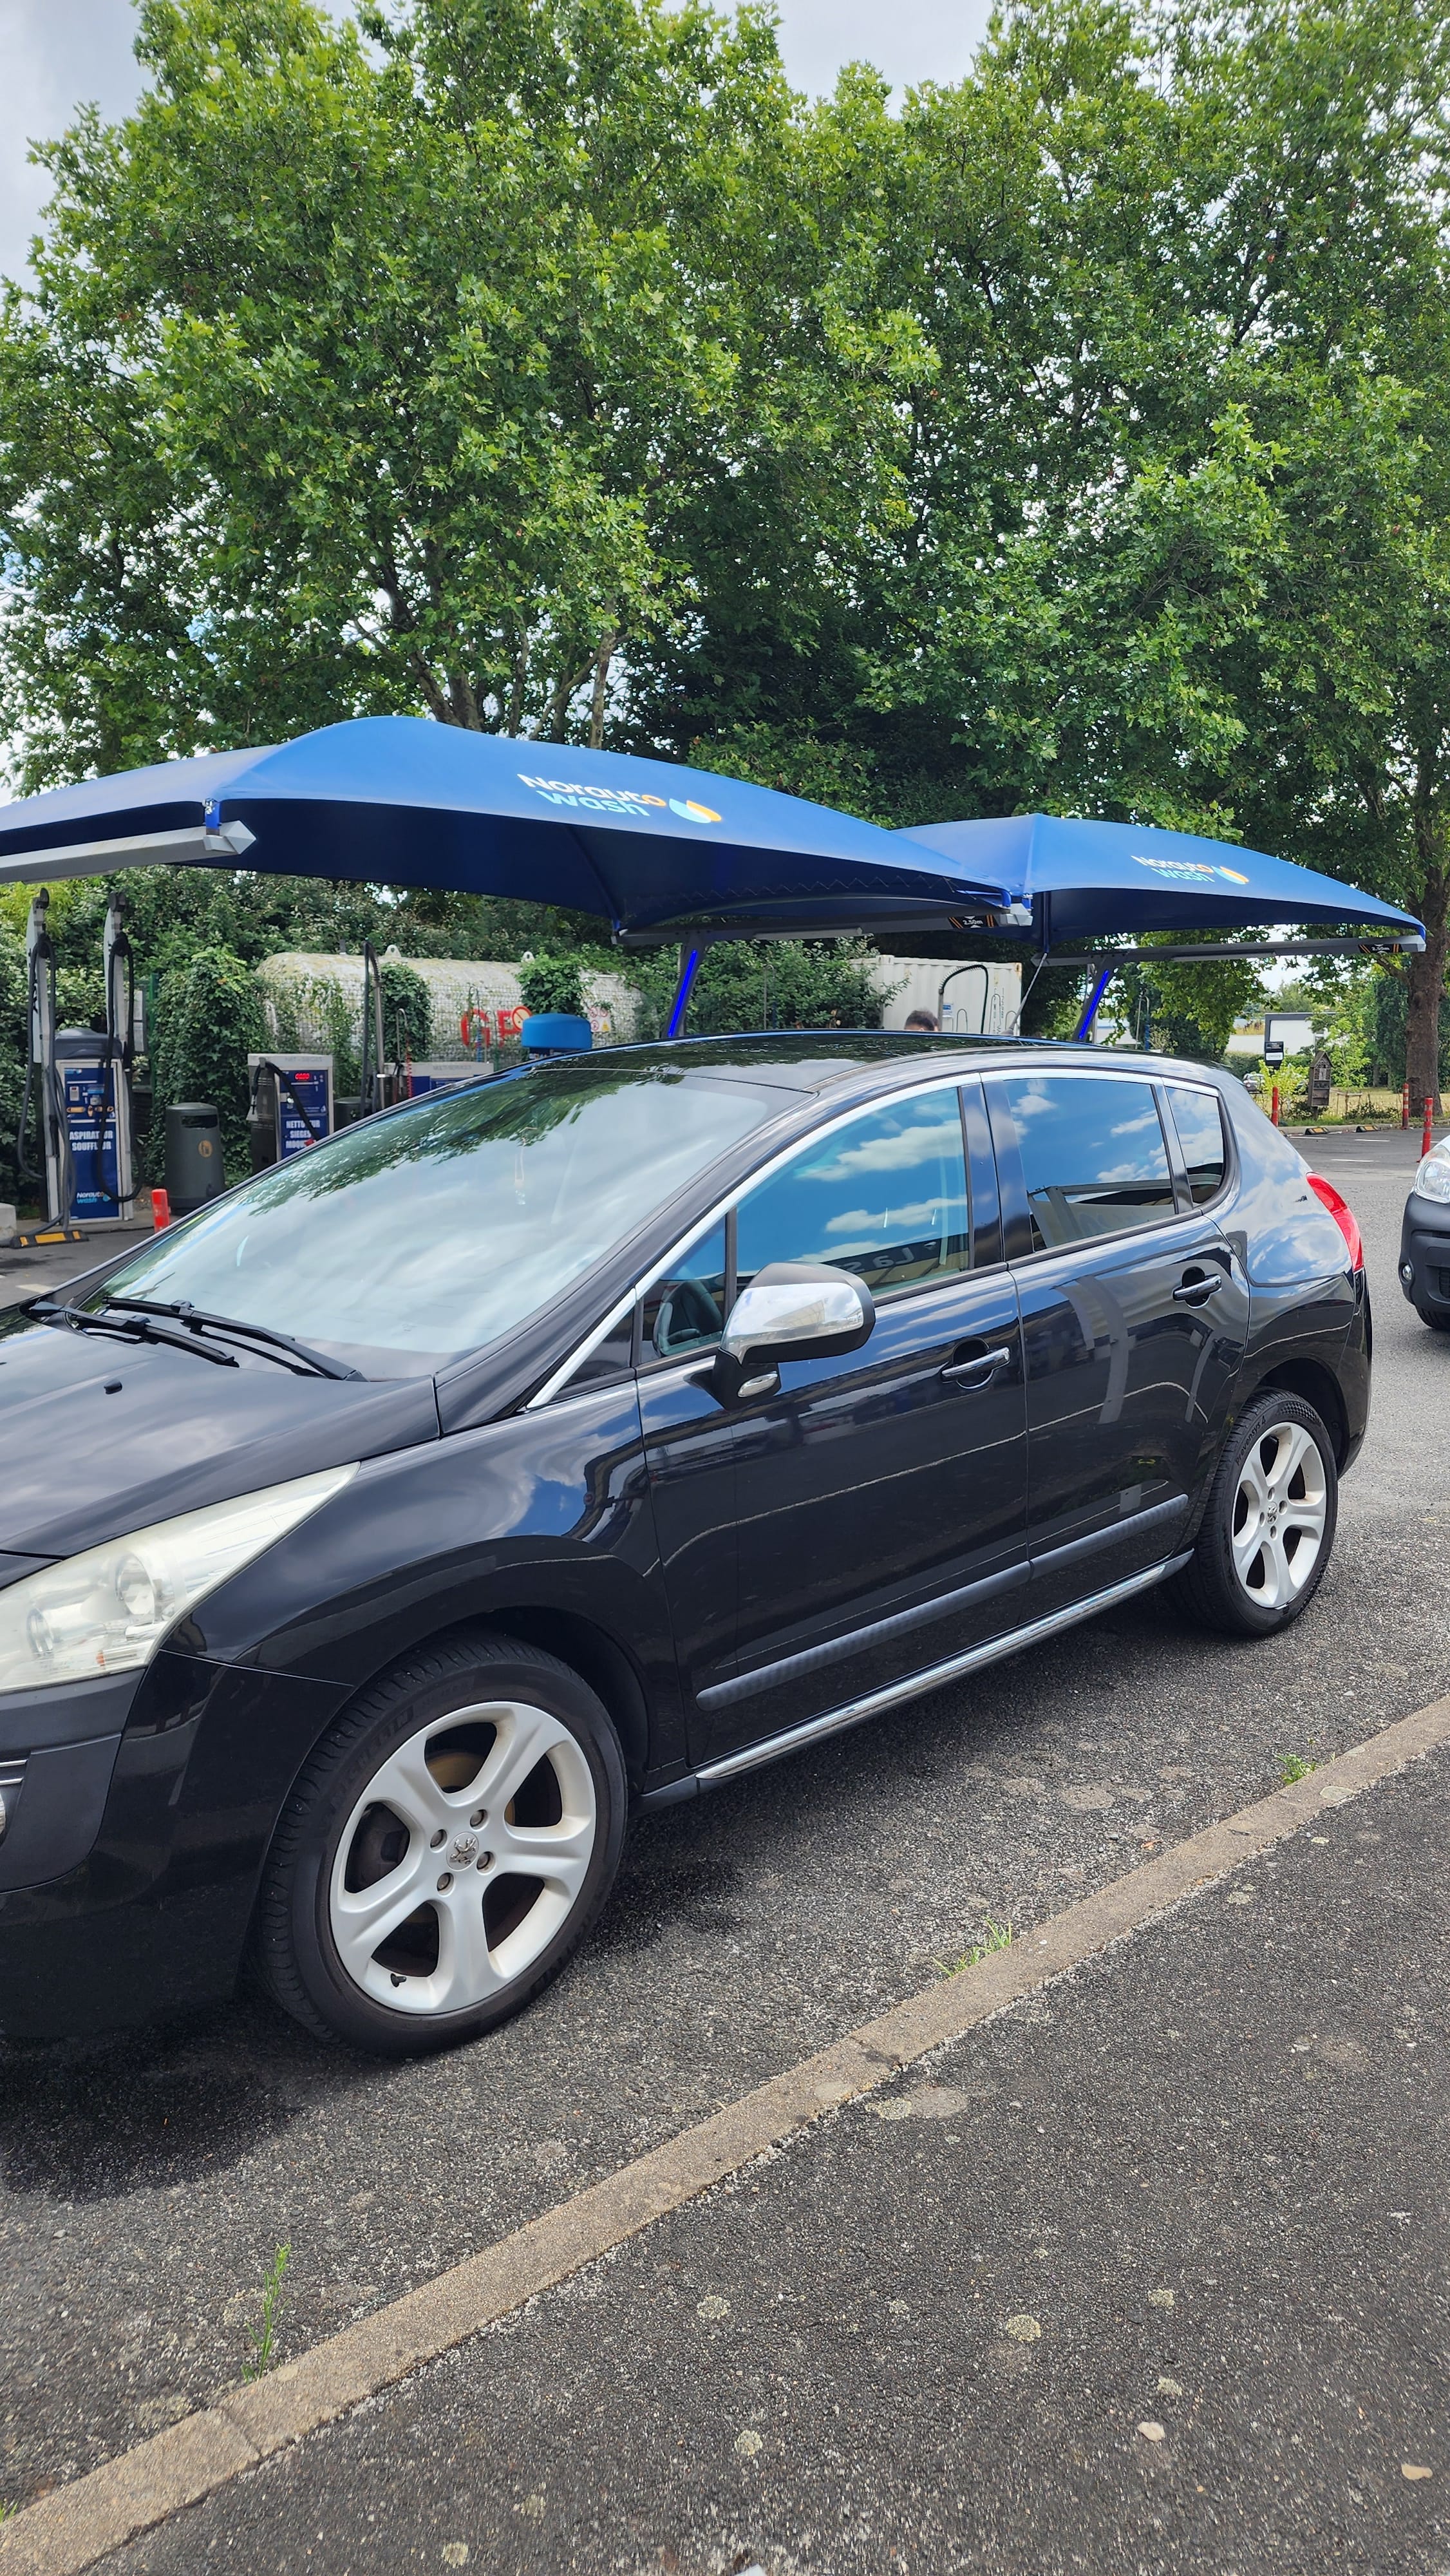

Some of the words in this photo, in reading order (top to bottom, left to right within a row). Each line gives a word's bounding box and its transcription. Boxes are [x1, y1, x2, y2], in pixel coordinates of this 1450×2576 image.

[516, 773, 666, 808] Norauto
[536, 790, 650, 817] wash
[1131, 855, 1214, 873] Norauto
[69, 1130, 113, 1141] ASPIRATUR
[71, 1141, 111, 1151] SOUFFLUR
[1235, 1421, 1261, 1466] Prevensys
